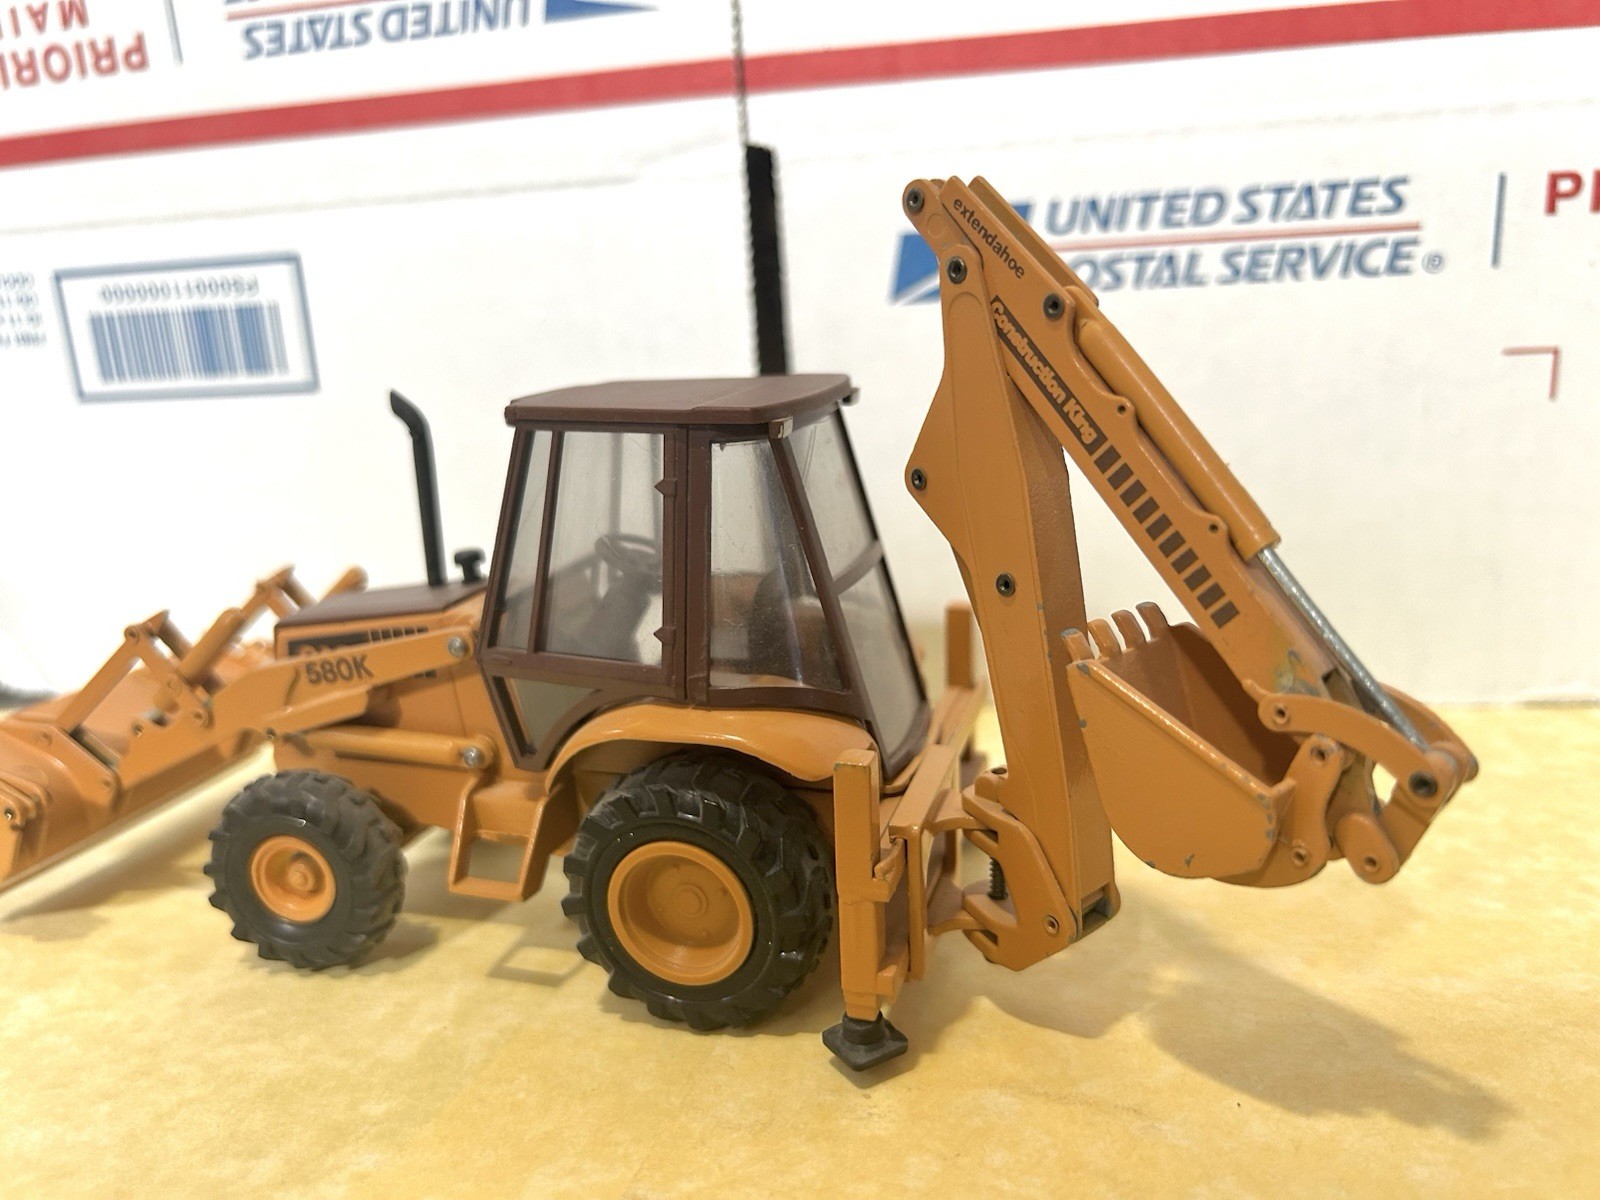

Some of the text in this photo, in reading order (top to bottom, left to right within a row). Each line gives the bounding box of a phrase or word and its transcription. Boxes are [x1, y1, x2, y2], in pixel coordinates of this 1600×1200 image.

[0, 0, 89, 39] MAI
[242, 0, 530, 61] UNITED STATES
[1045, 174, 1410, 236] UNITED STATES
[1544, 169, 1600, 217] P
[952, 197, 1025, 280] extendahoe
[1068, 236, 1421, 292] OSTAL SERVICE
[991, 300, 1098, 446] Construction King
[304, 654, 374, 686] 580K
